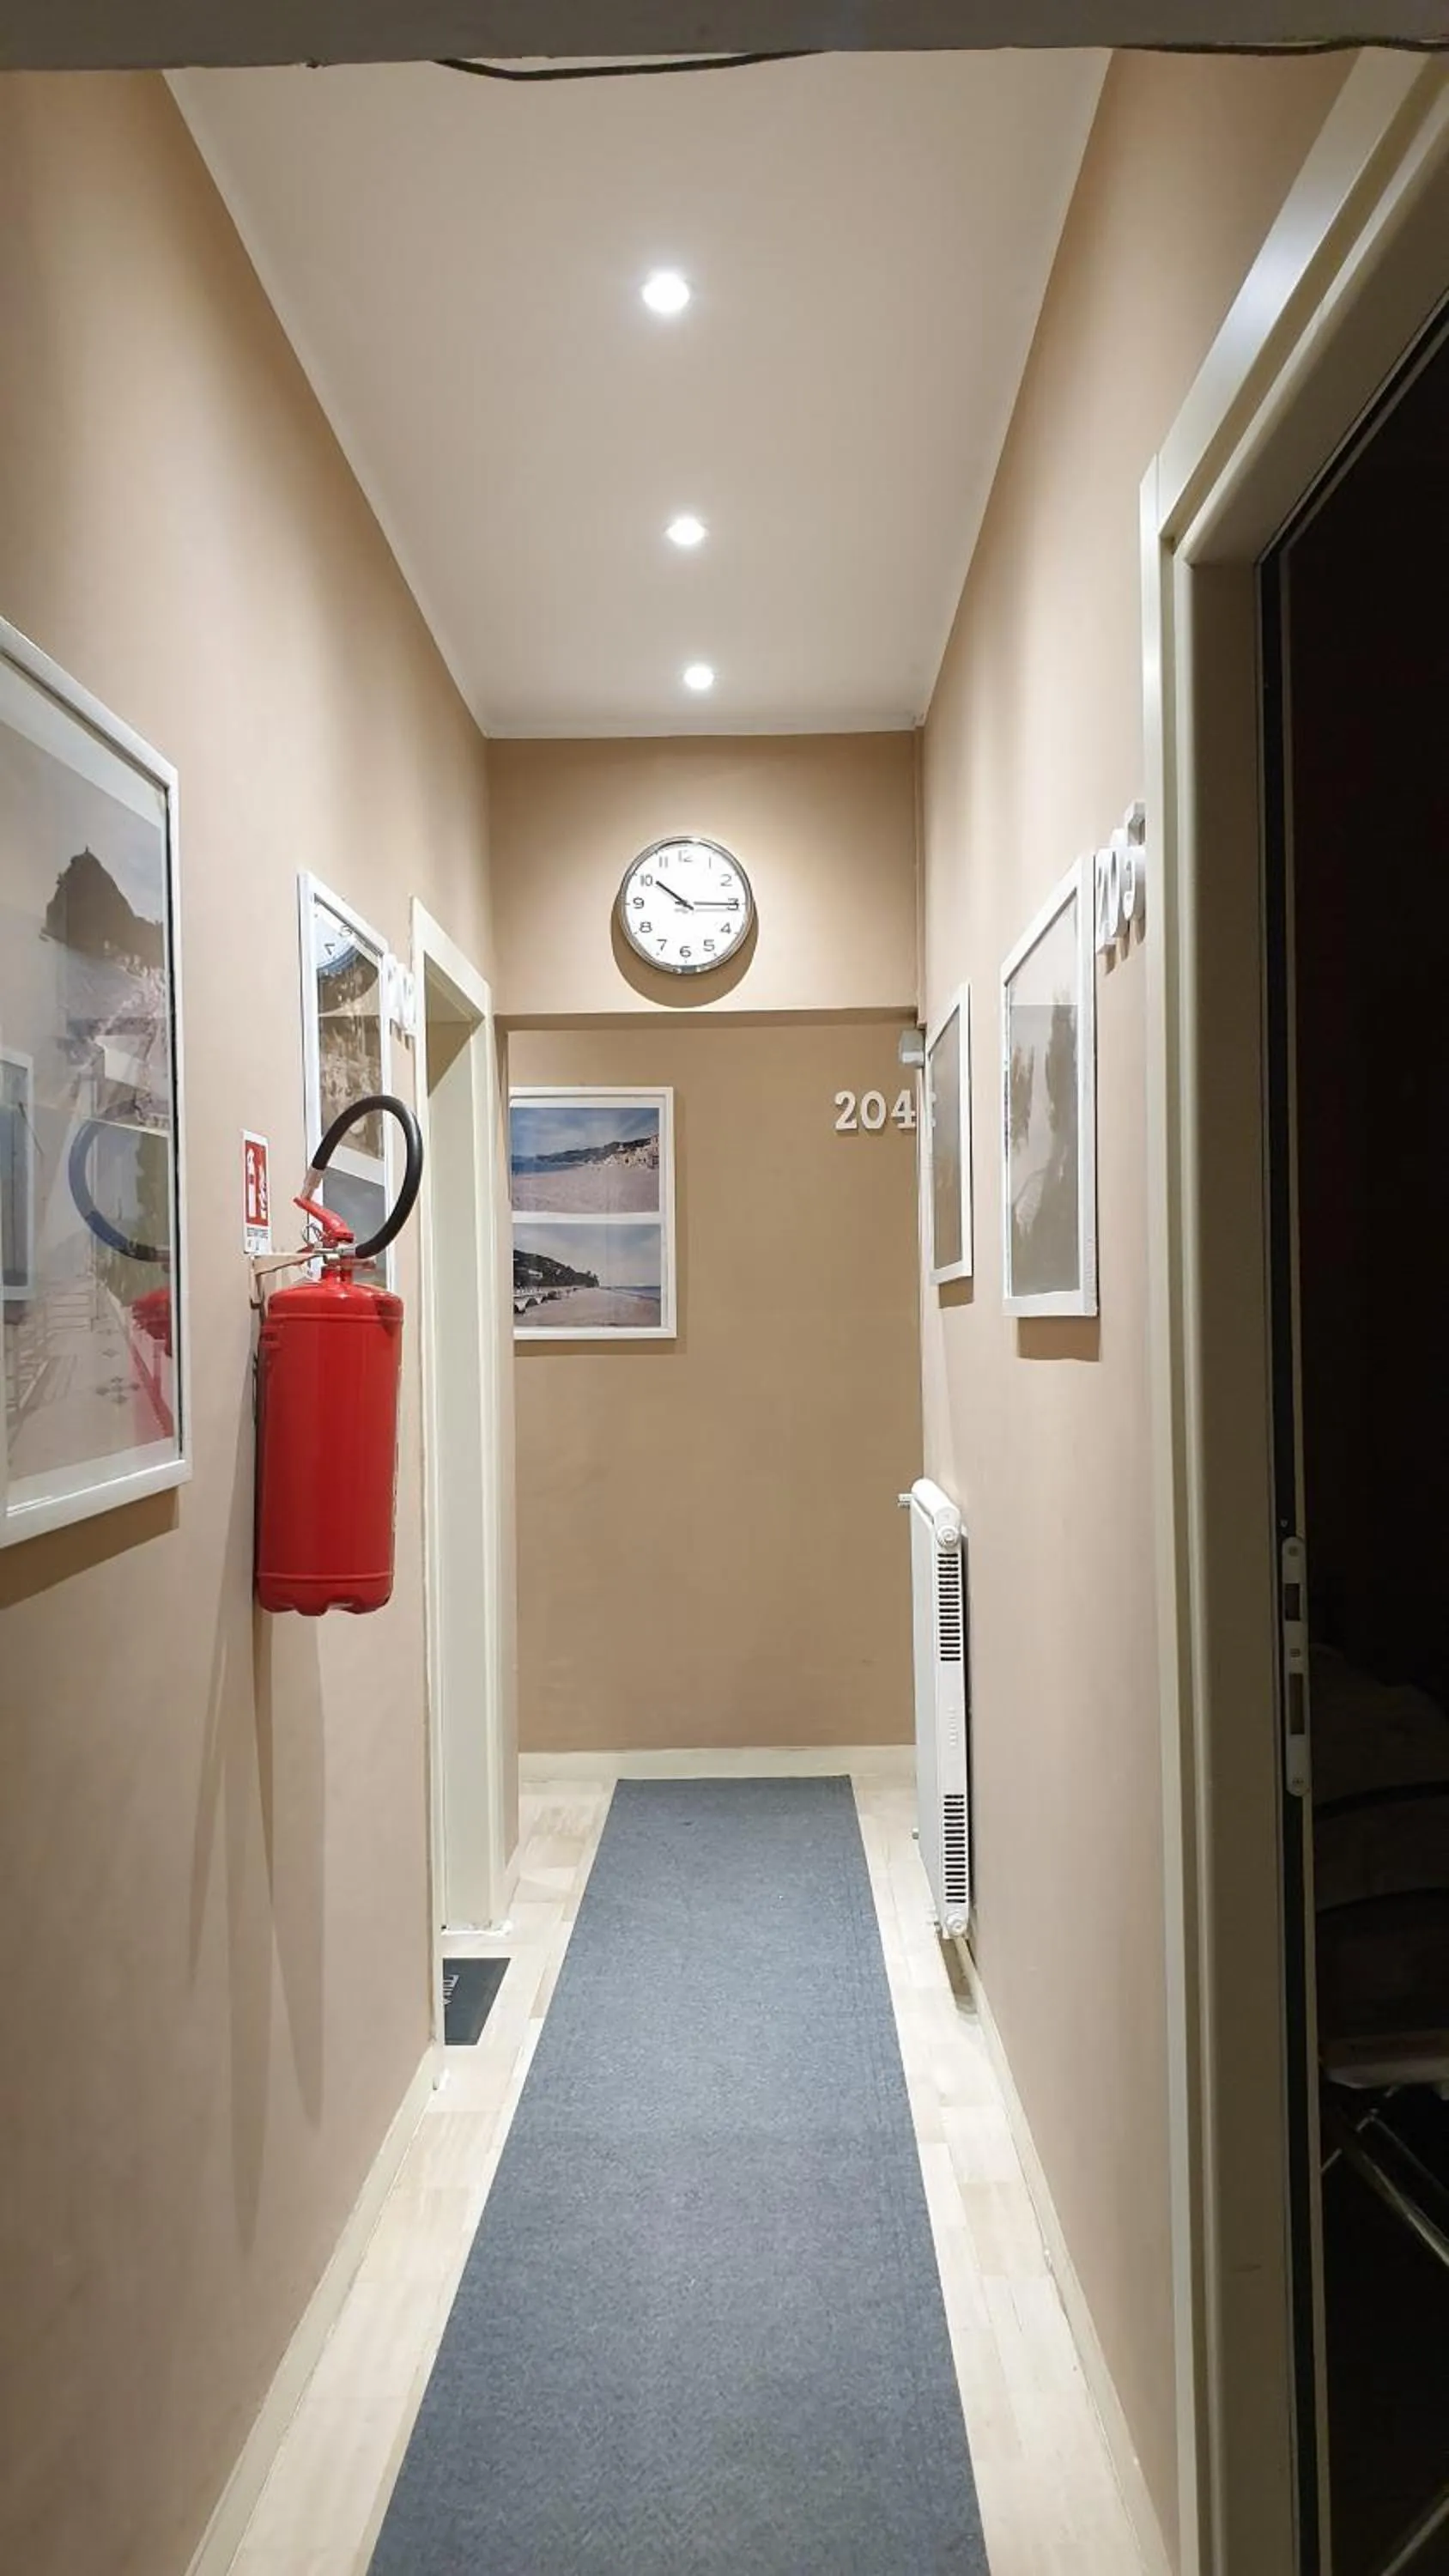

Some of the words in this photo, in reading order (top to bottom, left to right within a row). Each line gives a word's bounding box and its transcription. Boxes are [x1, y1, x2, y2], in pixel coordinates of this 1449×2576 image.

[658, 856, 668, 868] 11
[678, 849, 694, 863] 12
[640, 874, 653, 887] 10
[720, 873, 732, 887] 2
[633, 896, 645, 909] 9
[727, 897, 739, 911] 3
[639, 921, 652, 933] 8
[720, 922, 731, 934] 4
[656, 939, 668, 951] 7
[679, 945, 692, 958] 6
[703, 939, 715, 952] 5
[834, 1089, 917, 1130] 204
